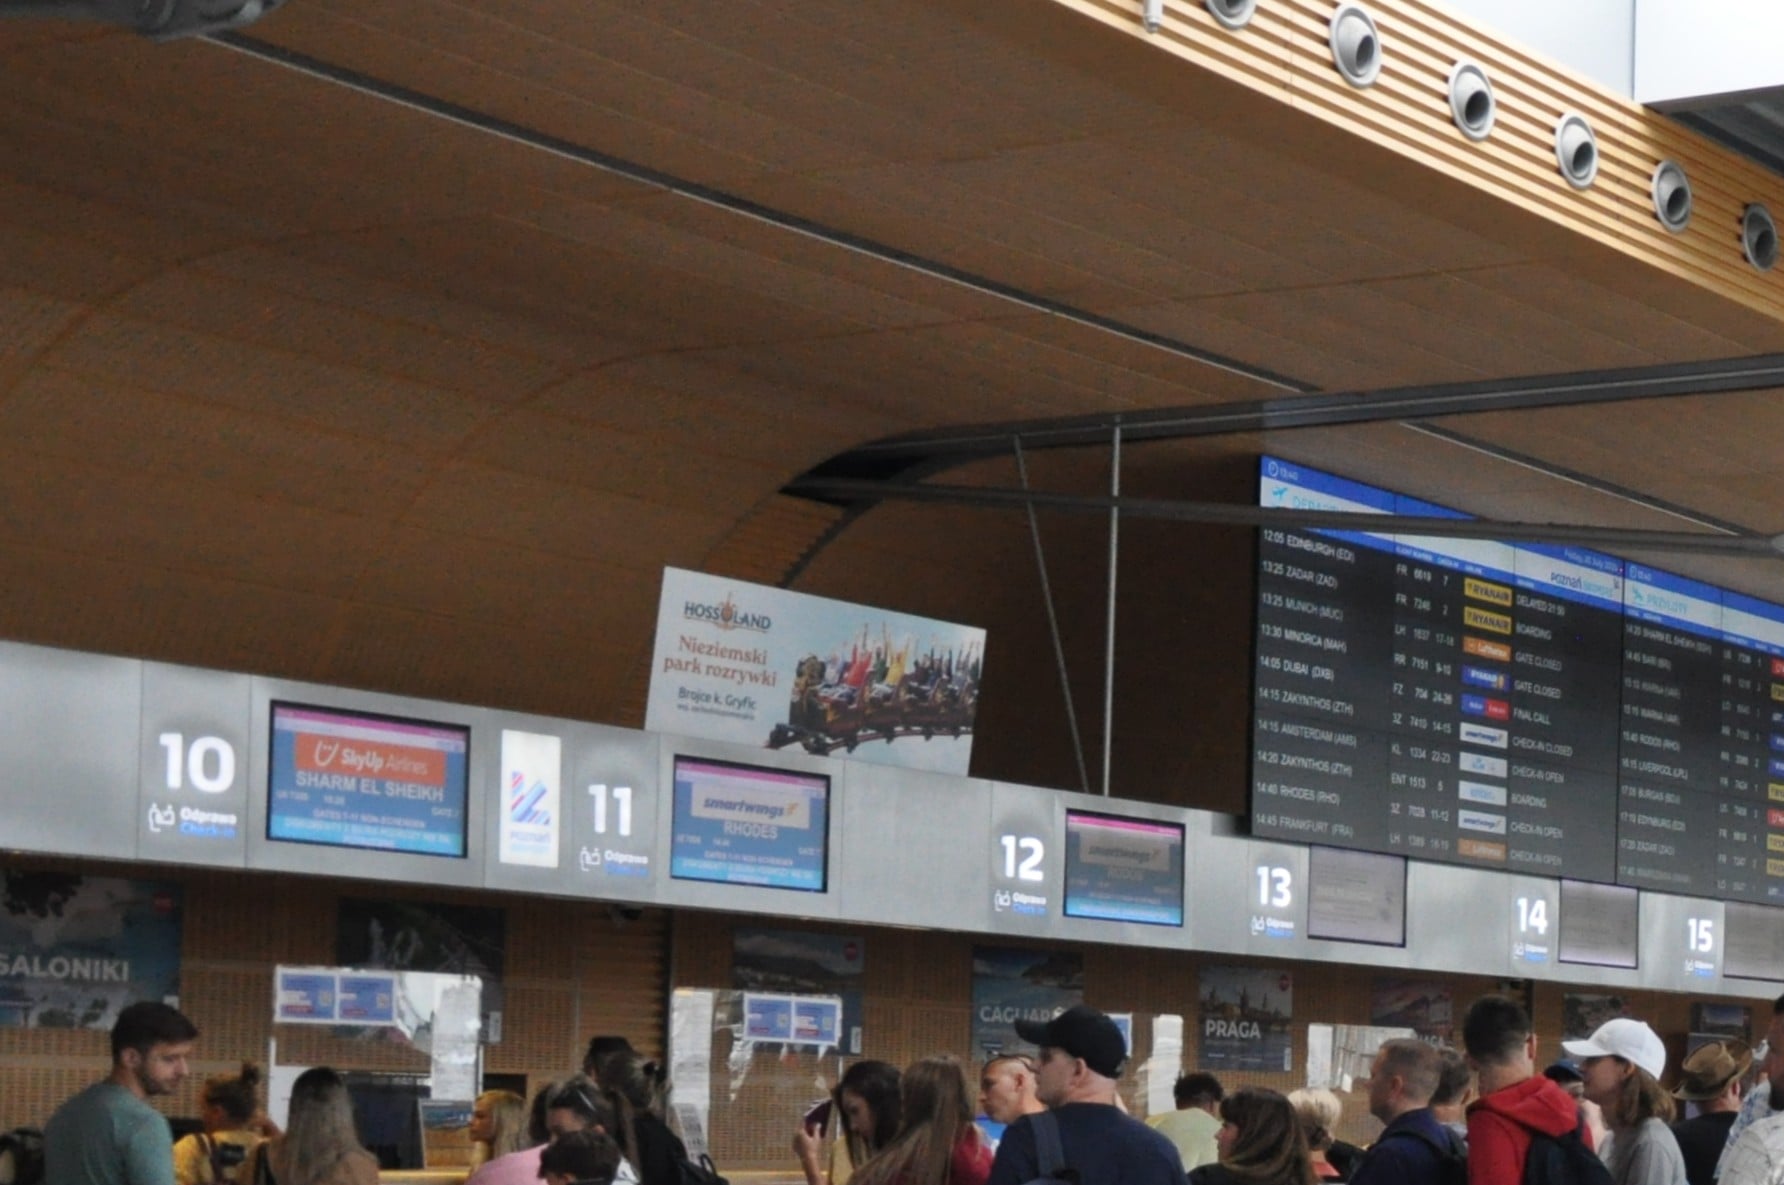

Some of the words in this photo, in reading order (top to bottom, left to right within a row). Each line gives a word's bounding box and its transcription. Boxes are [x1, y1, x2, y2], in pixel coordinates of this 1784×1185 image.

[1287, 535, 1335, 557] EDINBURGH
[1473, 586, 1510, 602] RYANAIR
[1286, 565, 1315, 583] ZADAR
[1473, 614, 1510, 631] RYANAIR
[679, 635, 768, 665] Nieziemski
[1284, 629, 1322, 647] MINORCA
[663, 654, 701, 676] park
[705, 663, 778, 688] rozrywki
[1283, 659, 1309, 675] DUBAI
[1282, 691, 1332, 711] ZAKYNTHOS
[1281, 723, 1333, 742] AMSTERDAM
[159, 732, 236, 793] 10
[341, 748, 384, 772] SkyUp
[1280, 754, 1330, 773] ZAKYNTHOS
[296, 771, 357, 793] SHARM
[361, 776, 381, 796] EL
[384, 782, 444, 803] SHEIKH
[1280, 785, 1315, 802] RHODES
[180, 807, 237, 826] Odprawa
[588, 784, 632, 836] 11
[703, 797, 785, 818] smartwings
[723, 821, 778, 839] RHODES
[1279, 816, 1329, 834] FRANKFURT
[1001, 834, 1045, 881] 12
[1257, 865, 1292, 907] 13
[1517, 897, 1548, 935] 14
[1687, 918, 1713, 952] 15
[1205, 1019, 1261, 1041] PRAGA
